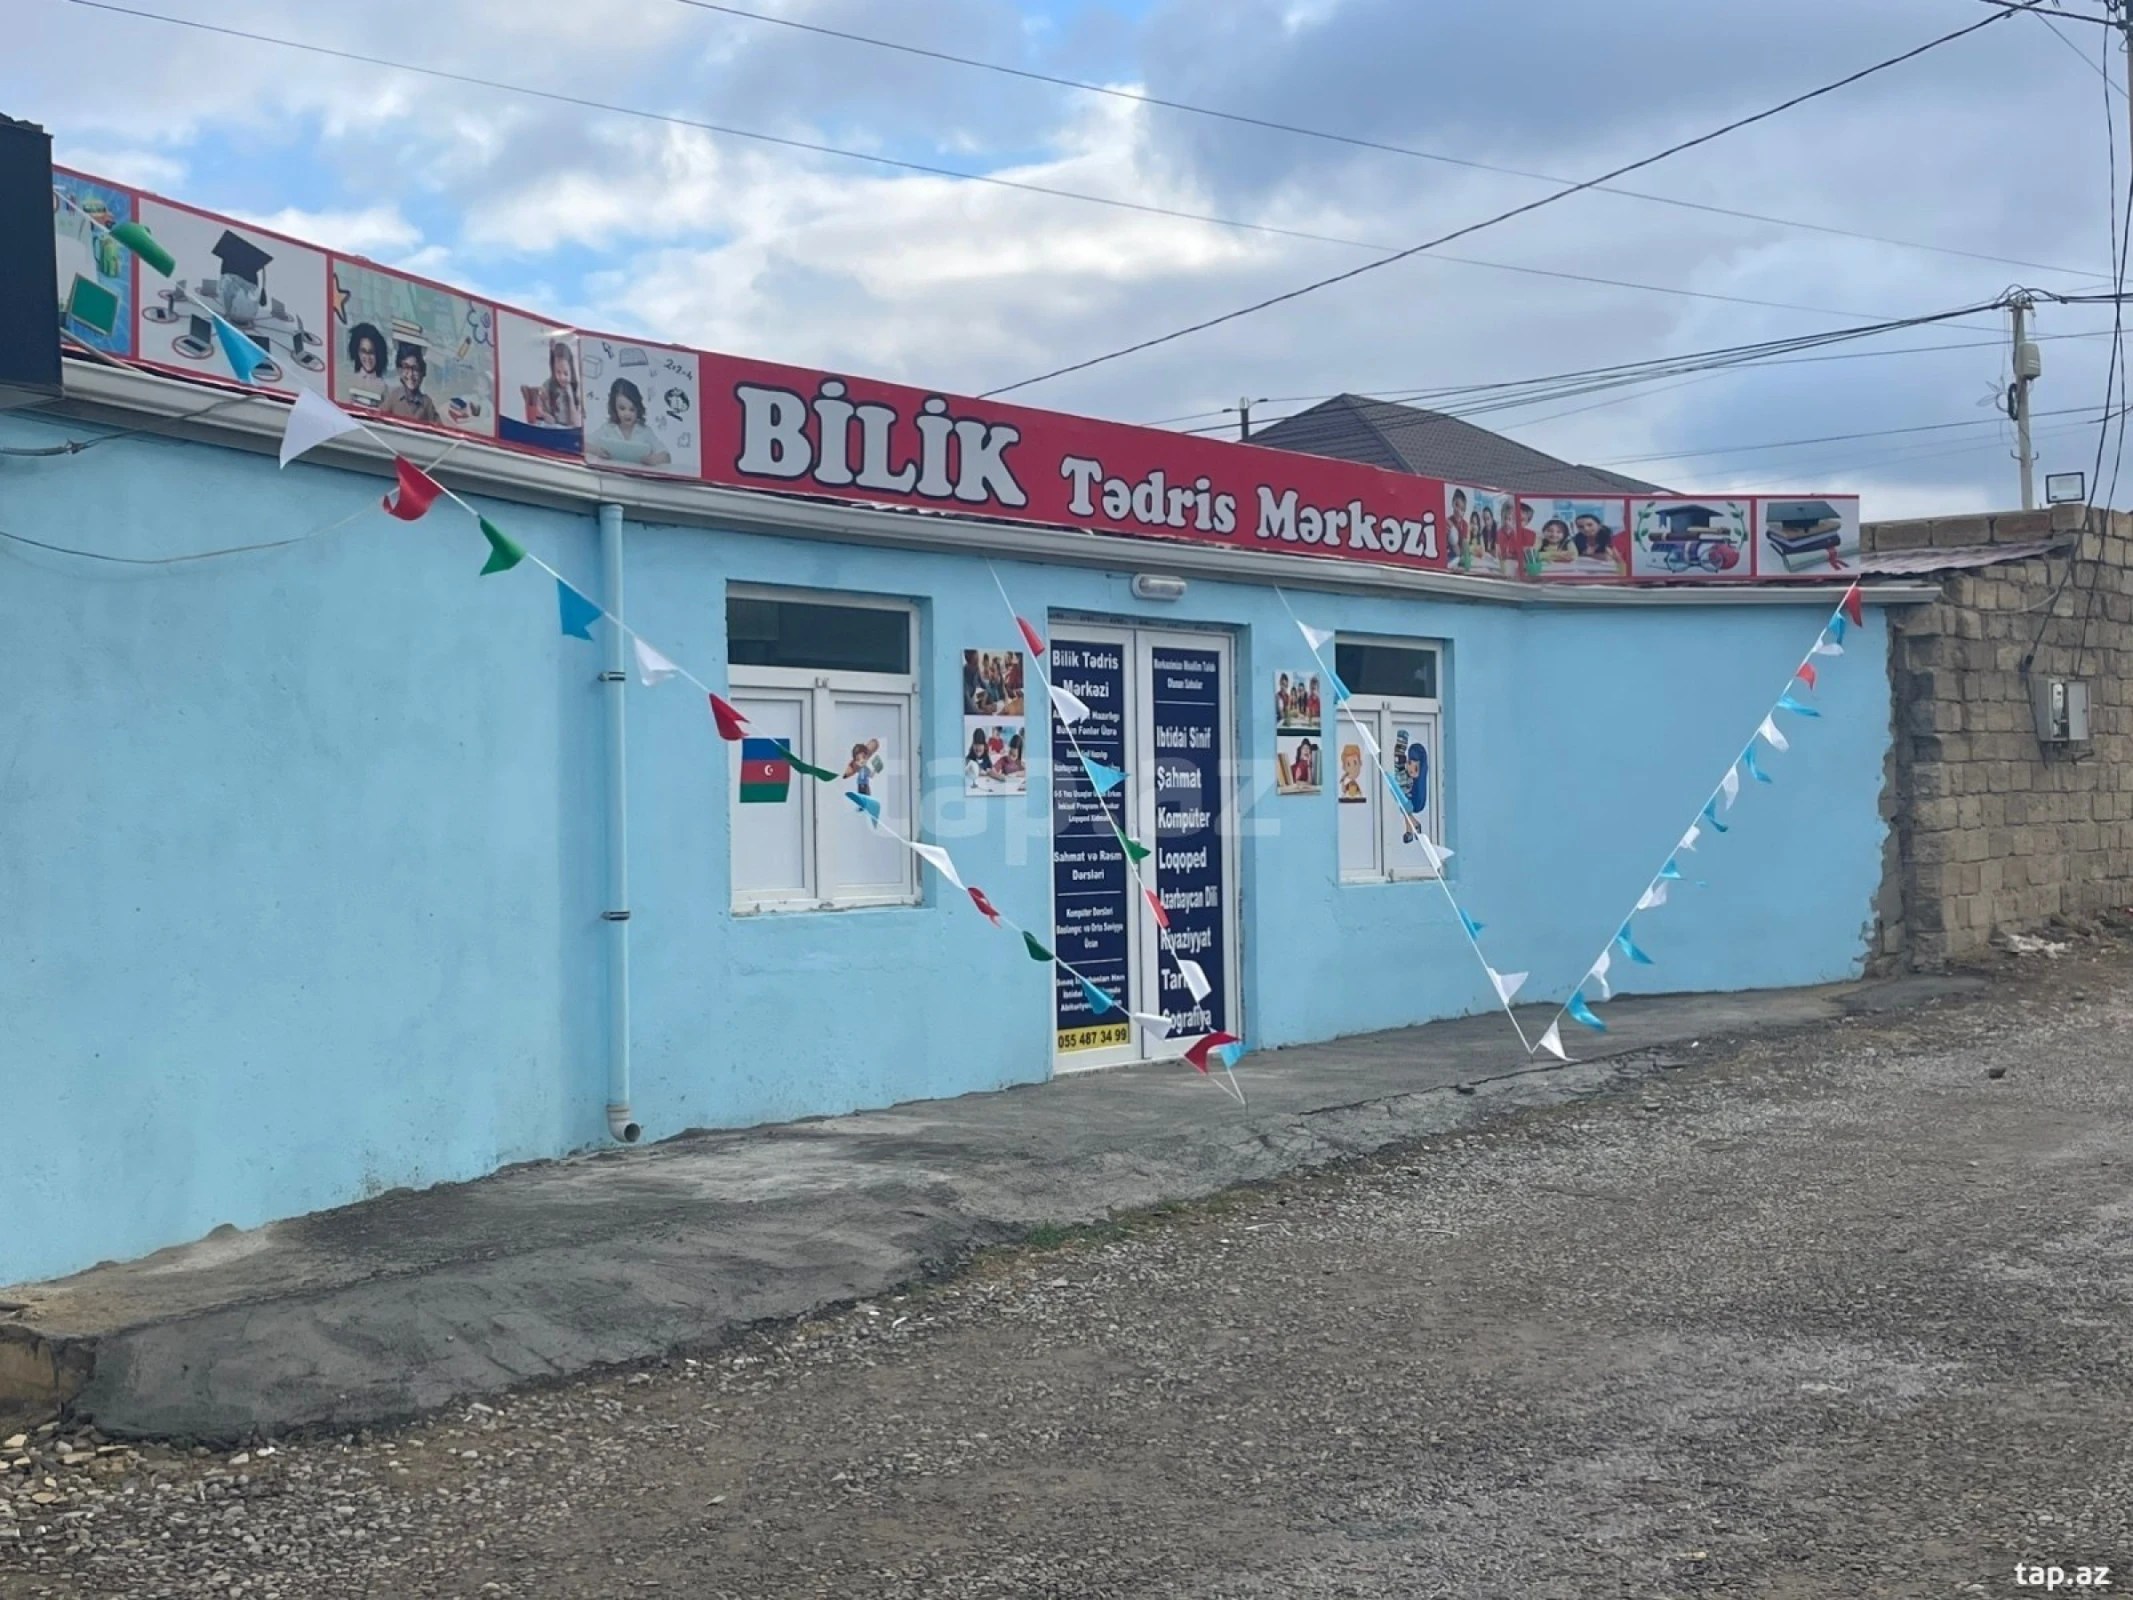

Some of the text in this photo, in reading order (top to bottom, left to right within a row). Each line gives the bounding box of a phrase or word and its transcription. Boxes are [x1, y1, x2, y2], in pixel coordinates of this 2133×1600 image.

[736, 377, 1439, 560] BİLİK Tədris Mərkəzi
[1052, 649, 1119, 670] Bilik Tədris
[1063, 679, 1110, 698] Mərkəzi
[1156, 765, 1202, 792] Şahmat
[1157, 806, 1211, 834] Kompüter
[1159, 845, 1208, 875] Loqoped
[1160, 926, 1212, 955] Riyaziyyat
[1058, 1027, 1127, 1049] 055 487 34 99
